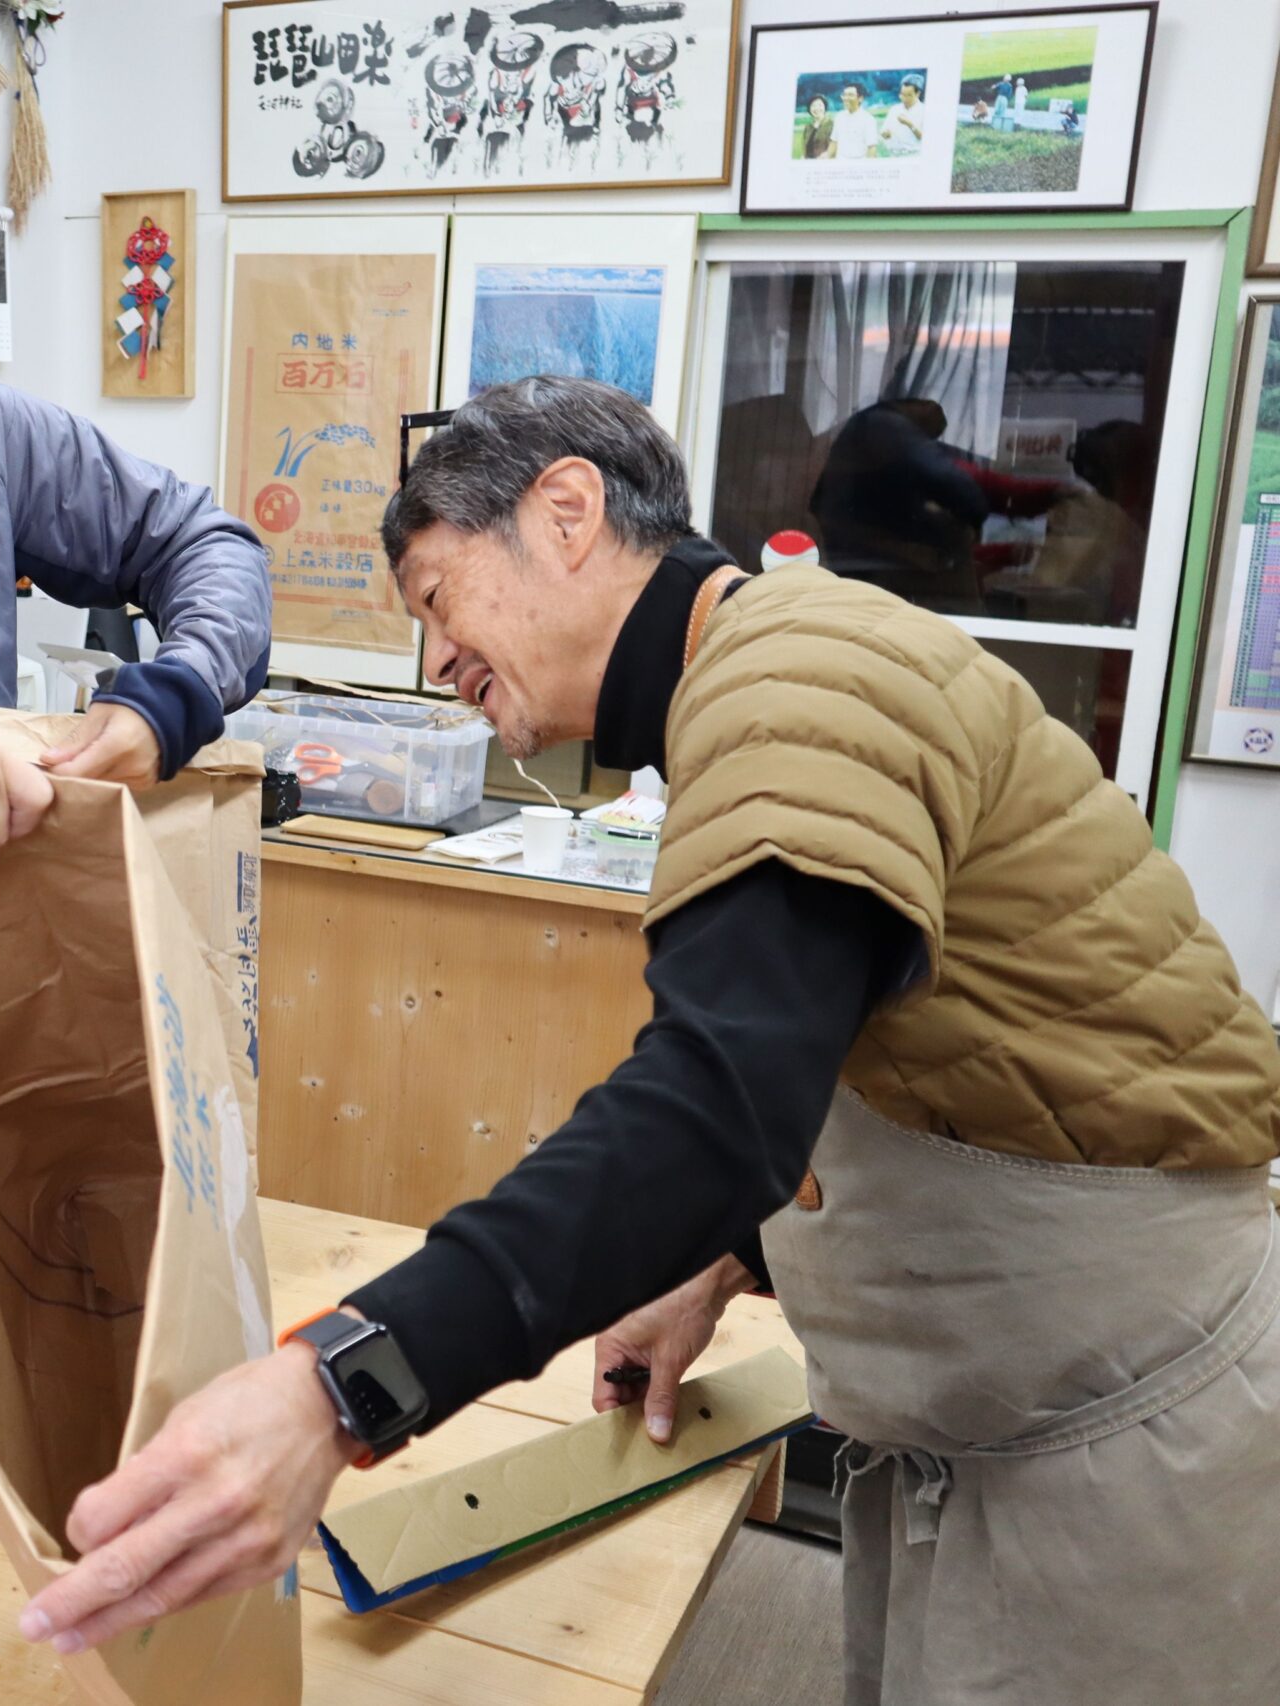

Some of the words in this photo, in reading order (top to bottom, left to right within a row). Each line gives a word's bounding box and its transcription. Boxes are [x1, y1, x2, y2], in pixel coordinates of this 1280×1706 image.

[291, 332, 358, 351] 内地米
[282, 360, 367, 389] 百万石
[281, 549, 375, 573] 上森米穀店
